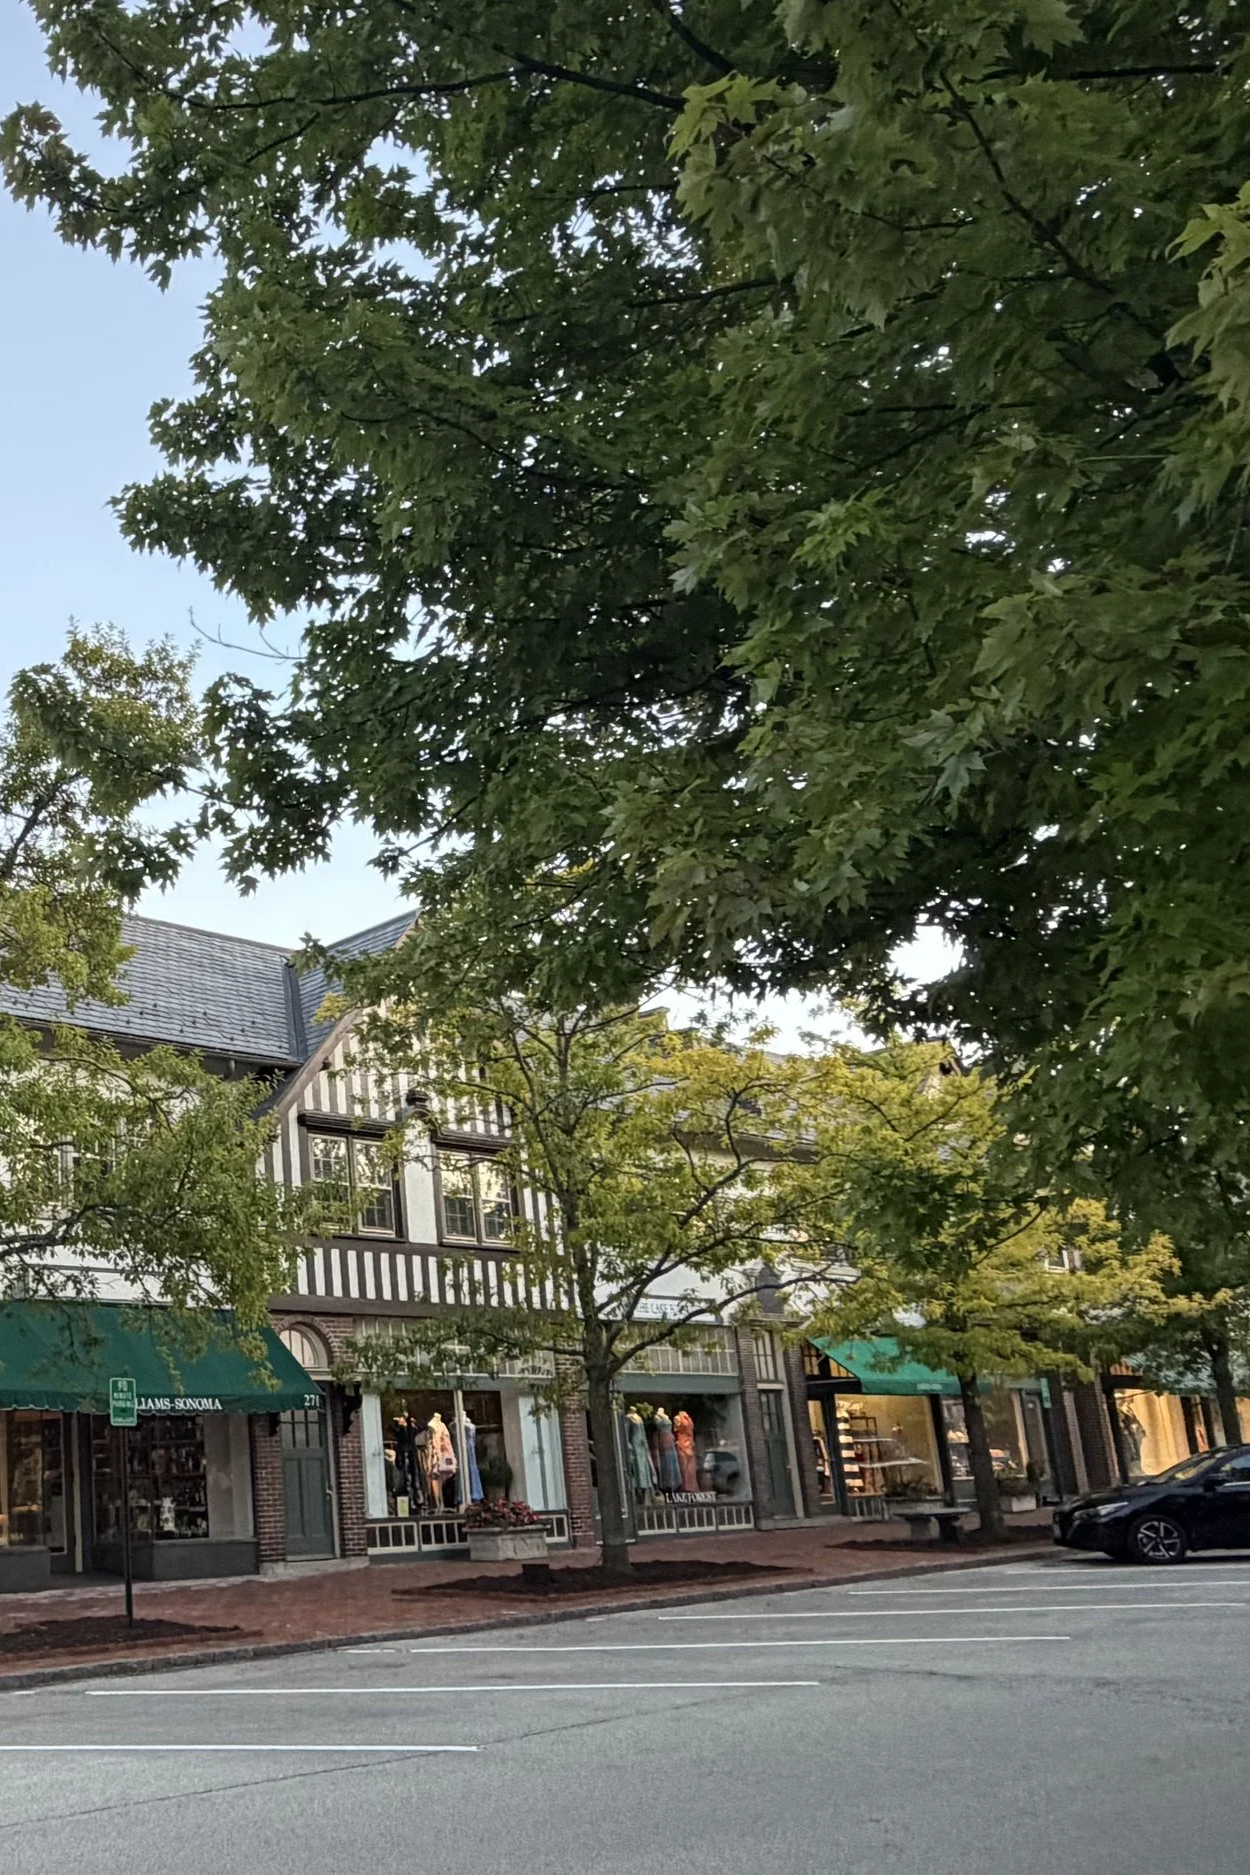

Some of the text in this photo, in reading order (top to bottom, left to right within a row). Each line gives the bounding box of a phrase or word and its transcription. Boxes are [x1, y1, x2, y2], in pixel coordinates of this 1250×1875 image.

[117, 1380, 128, 1391] 90
[135, 1397, 223, 1411] LIAMS-SONOMA
[303, 1394, 320, 1407] 271
